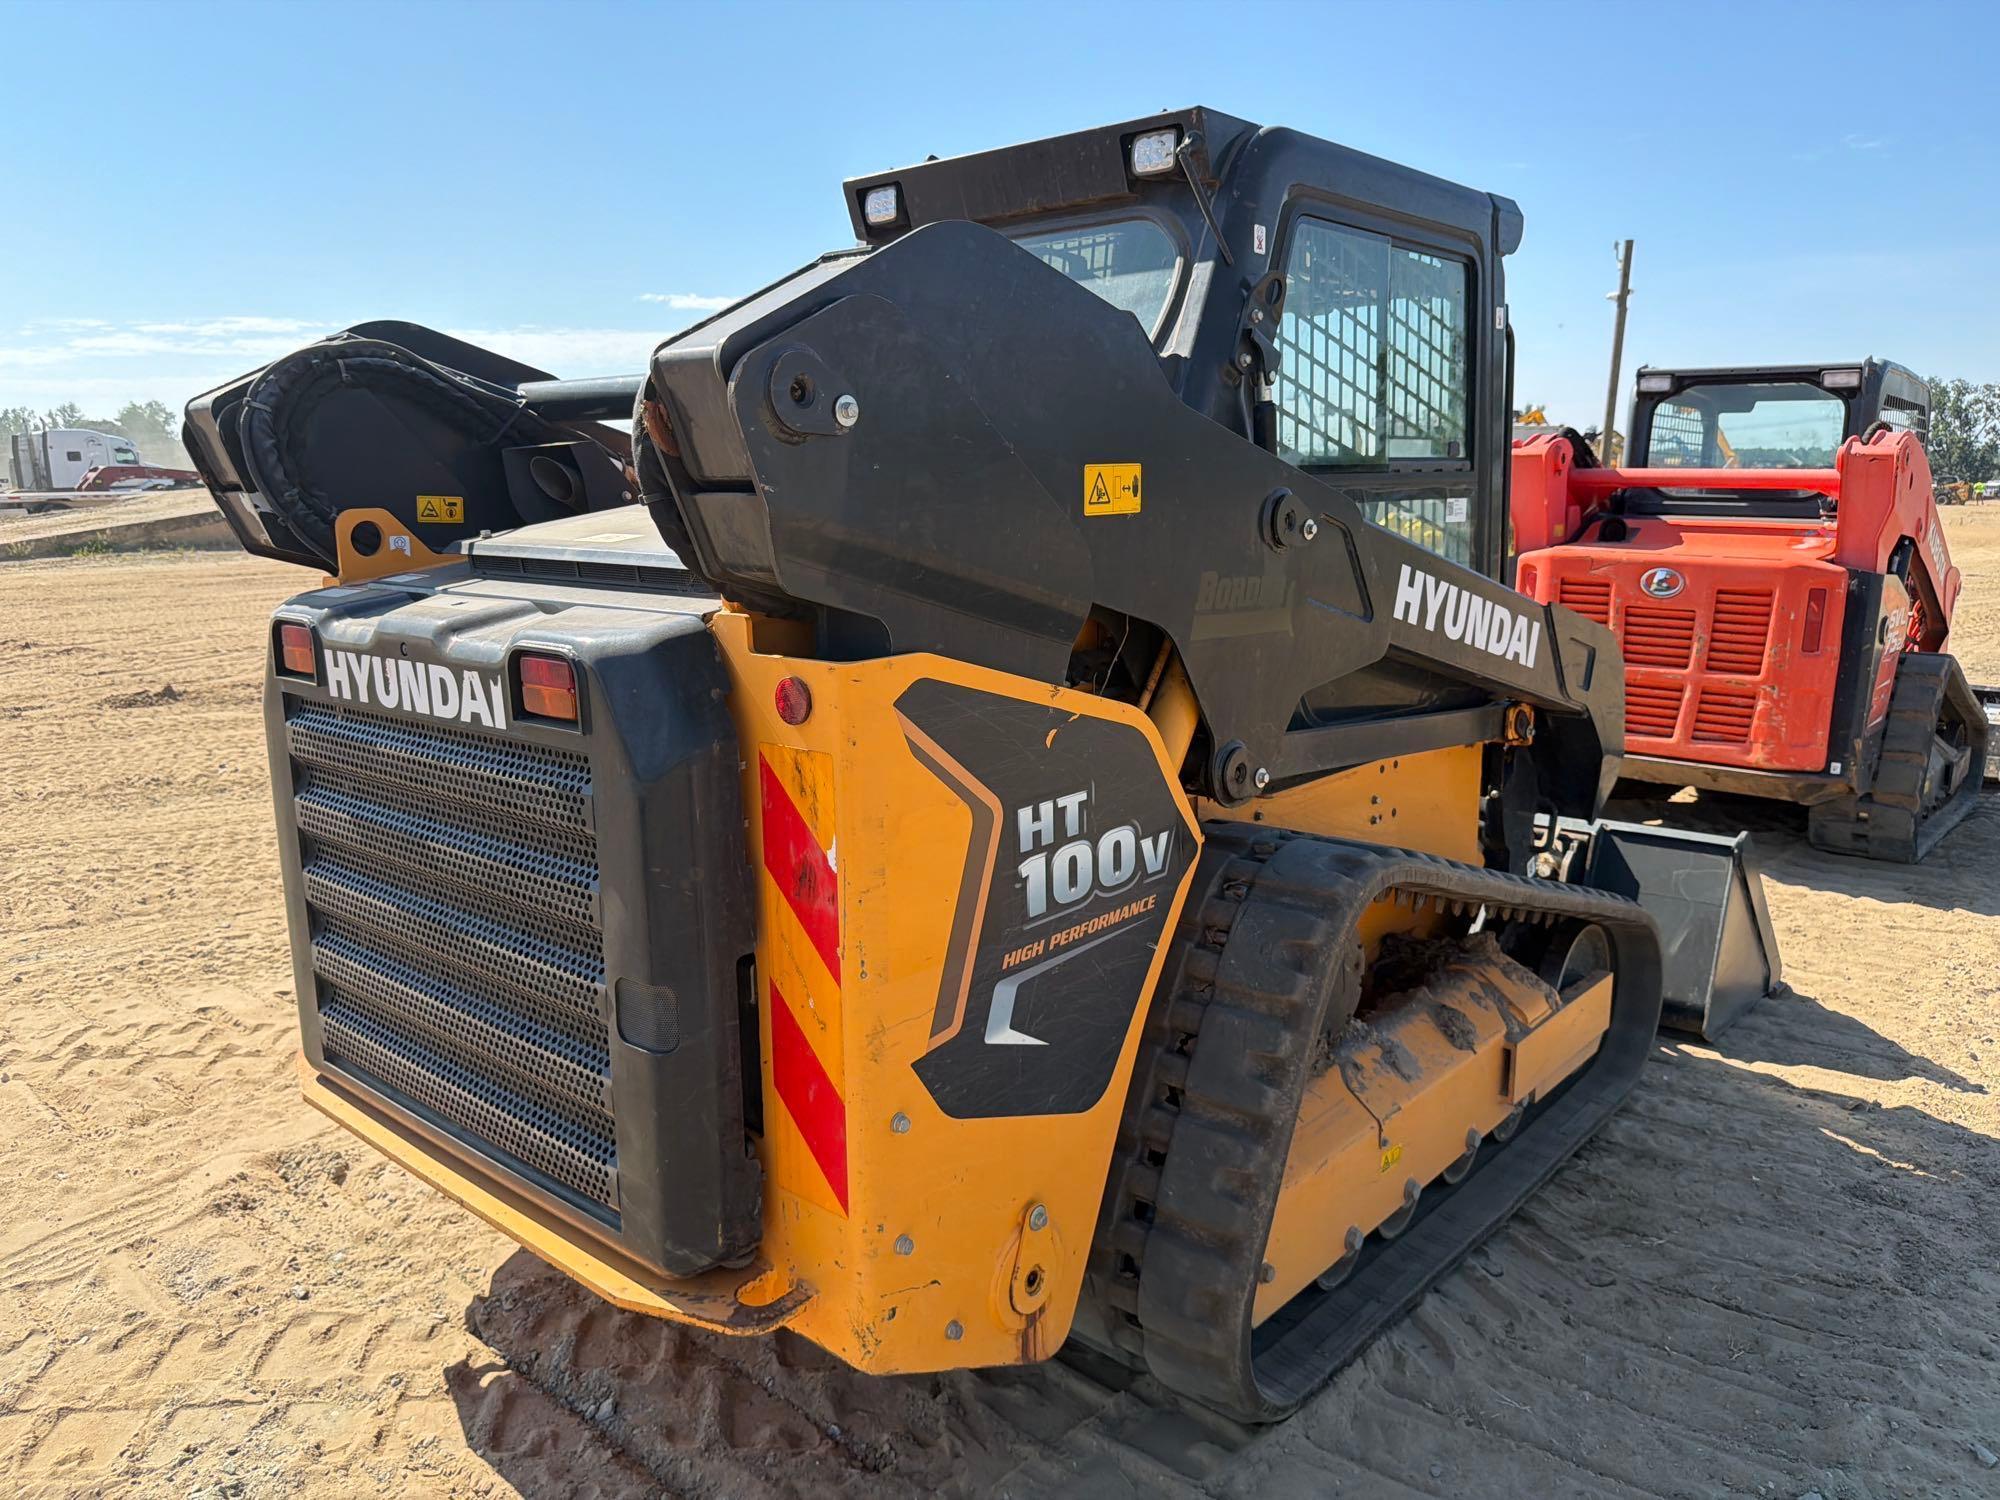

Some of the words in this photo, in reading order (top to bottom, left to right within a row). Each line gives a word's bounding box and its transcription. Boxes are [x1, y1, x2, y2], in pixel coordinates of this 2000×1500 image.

[1393, 564, 1541, 669] HYUNDAI
[324, 649, 507, 730] HYUNDAI
[1018, 790, 1088, 853] HT
[1002, 939, 1046, 970] HIGH
[1049, 894, 1157, 951] PERFORMANCE
